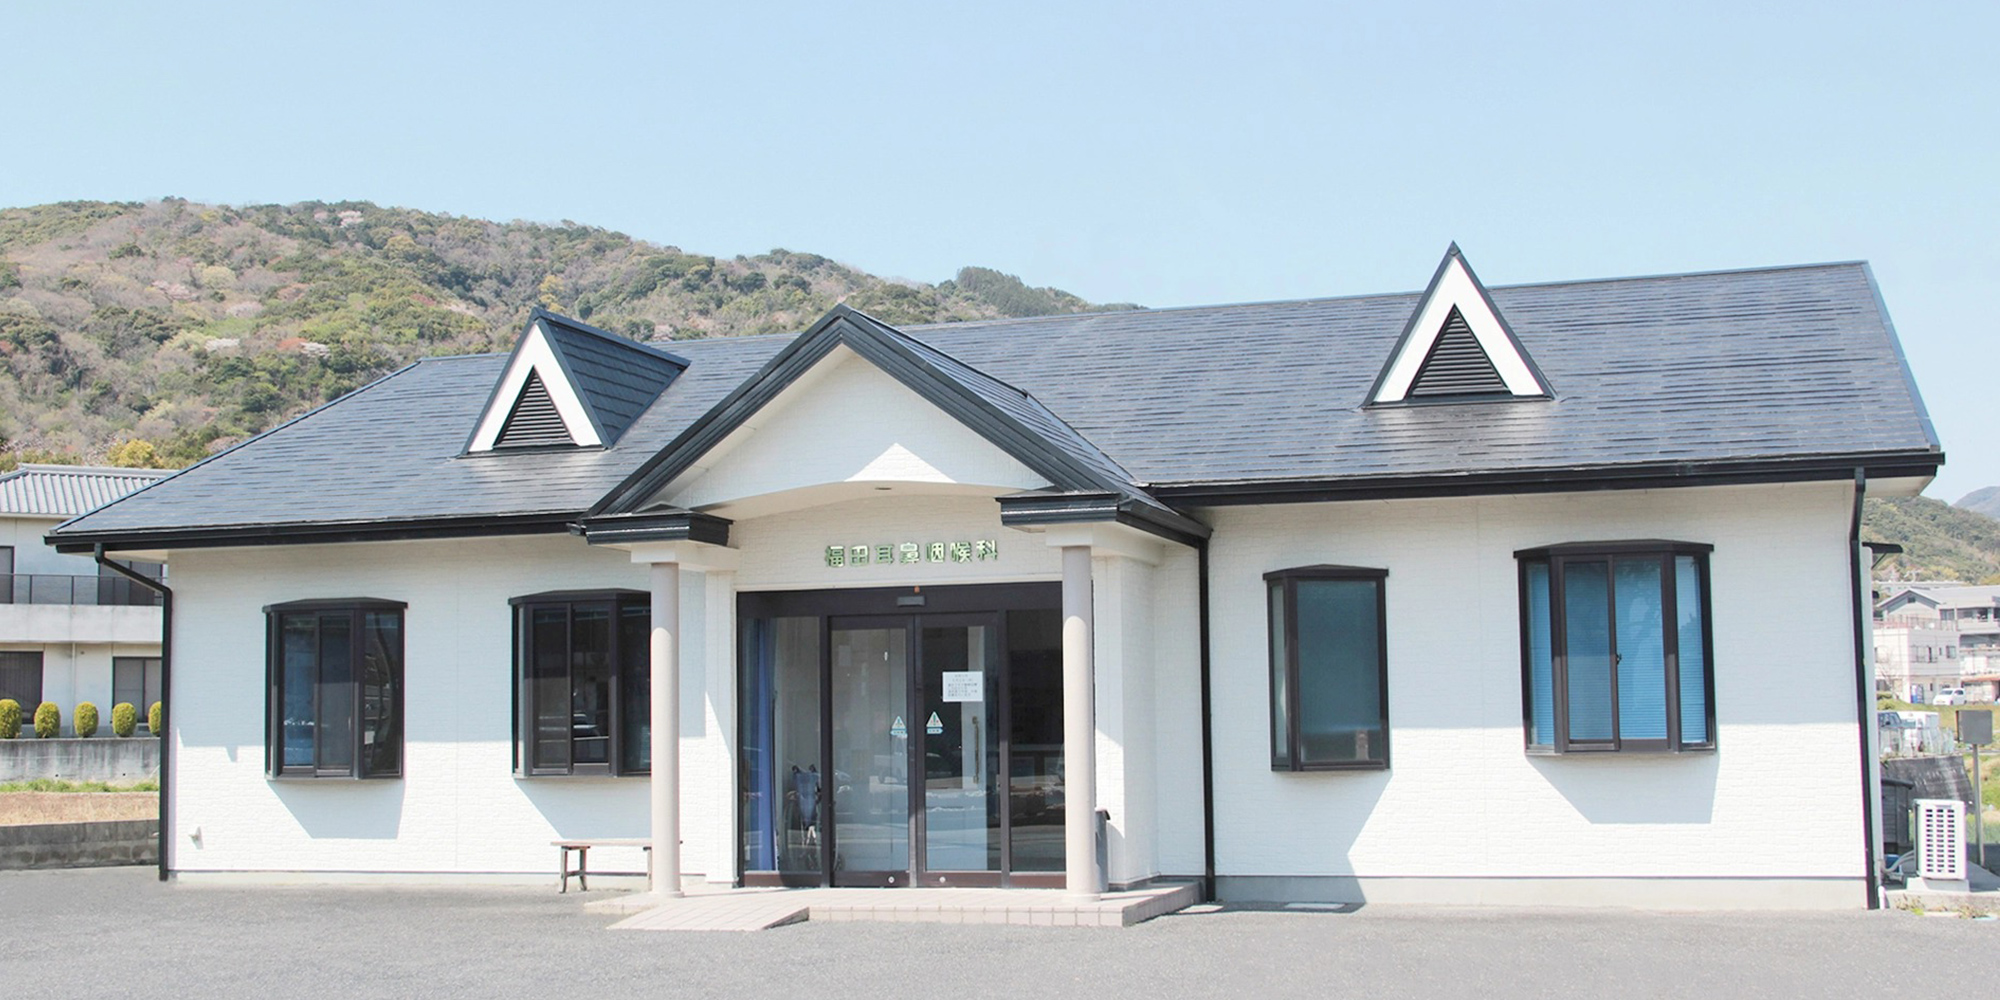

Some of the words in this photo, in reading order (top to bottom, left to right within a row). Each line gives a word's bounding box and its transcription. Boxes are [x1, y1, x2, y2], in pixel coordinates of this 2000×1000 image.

[825, 539, 998, 568] 福田耳鼻咽喉科
